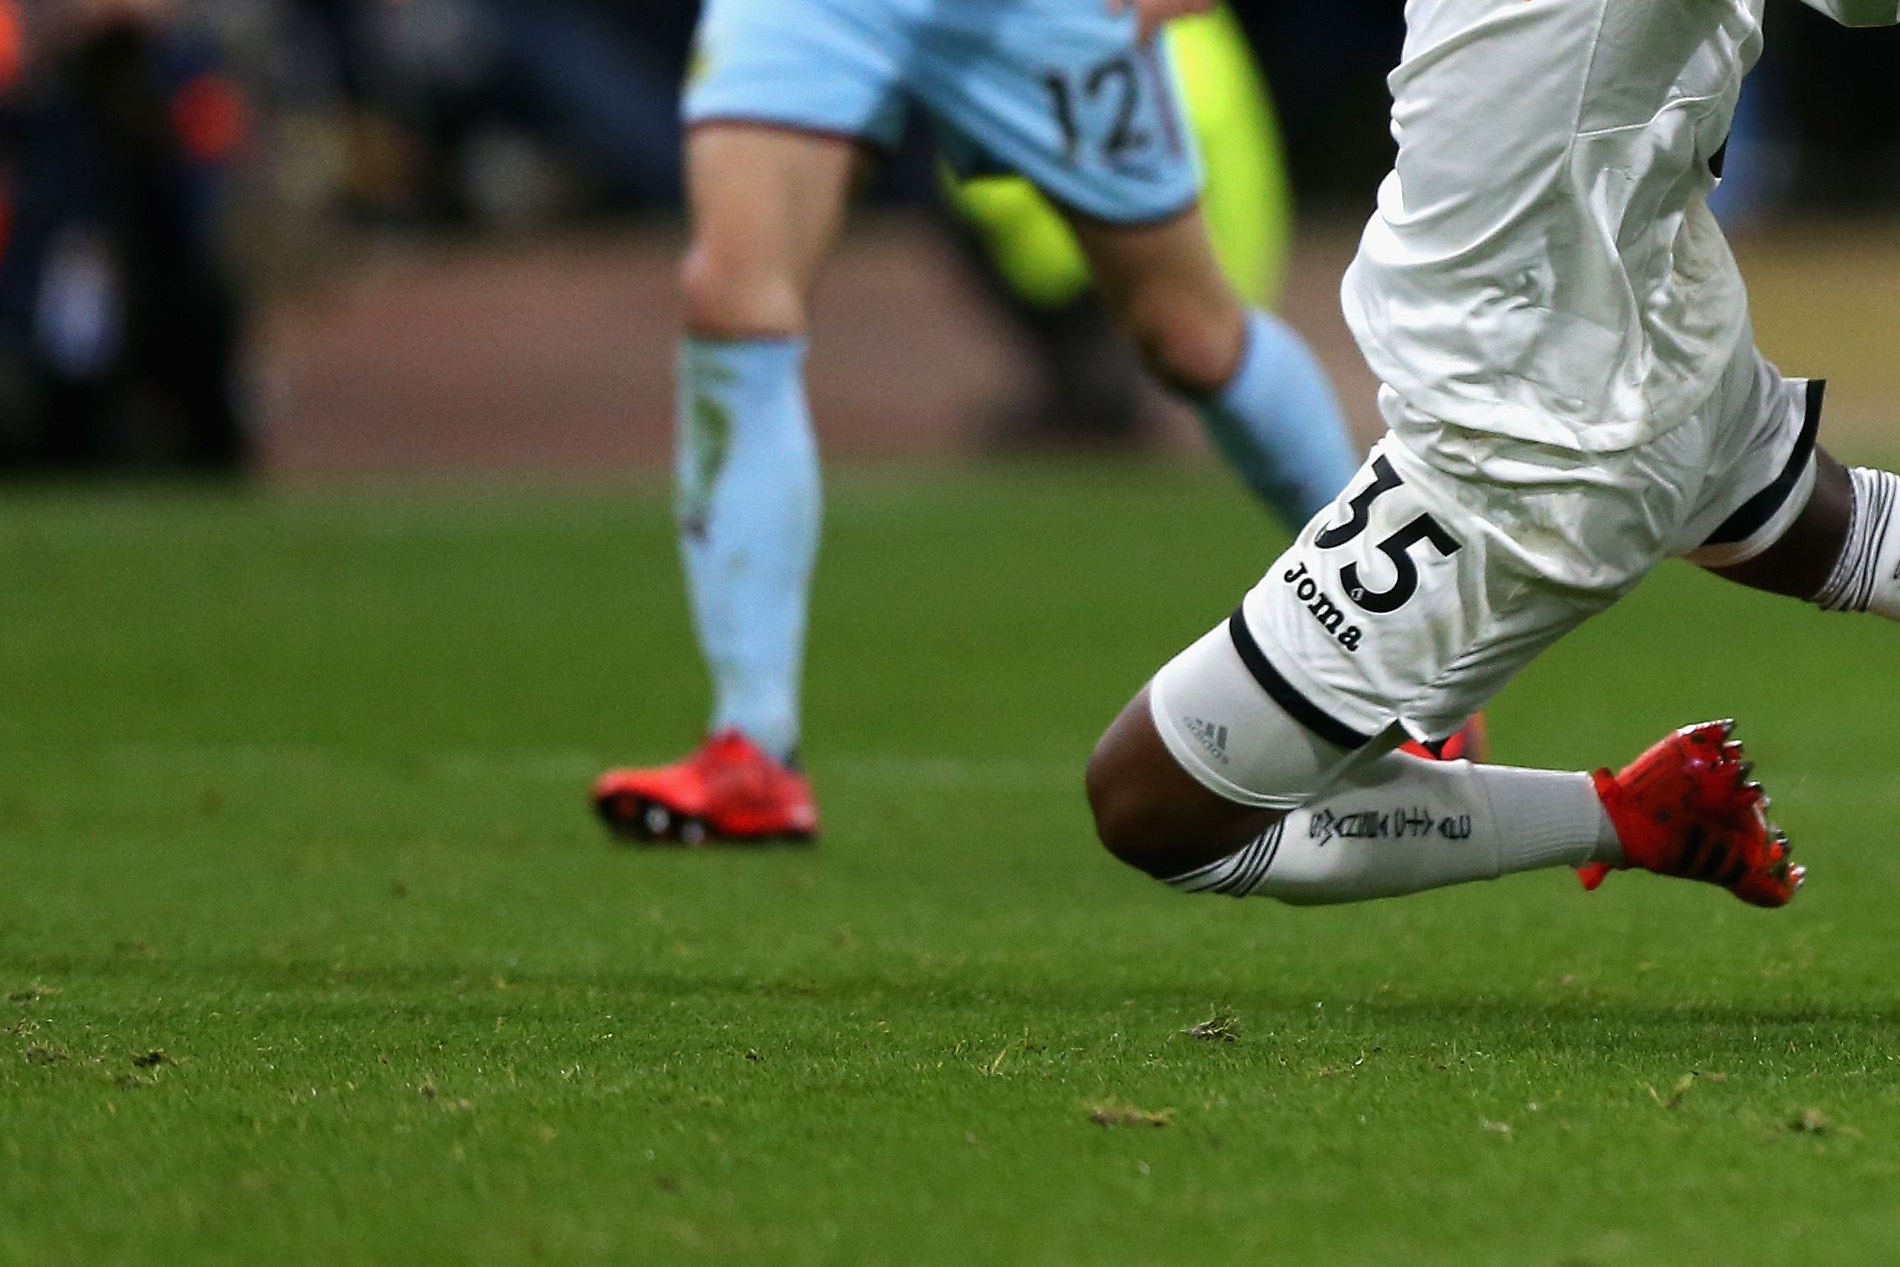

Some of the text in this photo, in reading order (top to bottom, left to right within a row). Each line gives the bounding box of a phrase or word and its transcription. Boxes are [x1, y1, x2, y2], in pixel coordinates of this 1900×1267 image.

[1044, 56, 1156, 154] 12
[1314, 453, 1463, 614] 35
[1283, 562, 1364, 652] Joma
